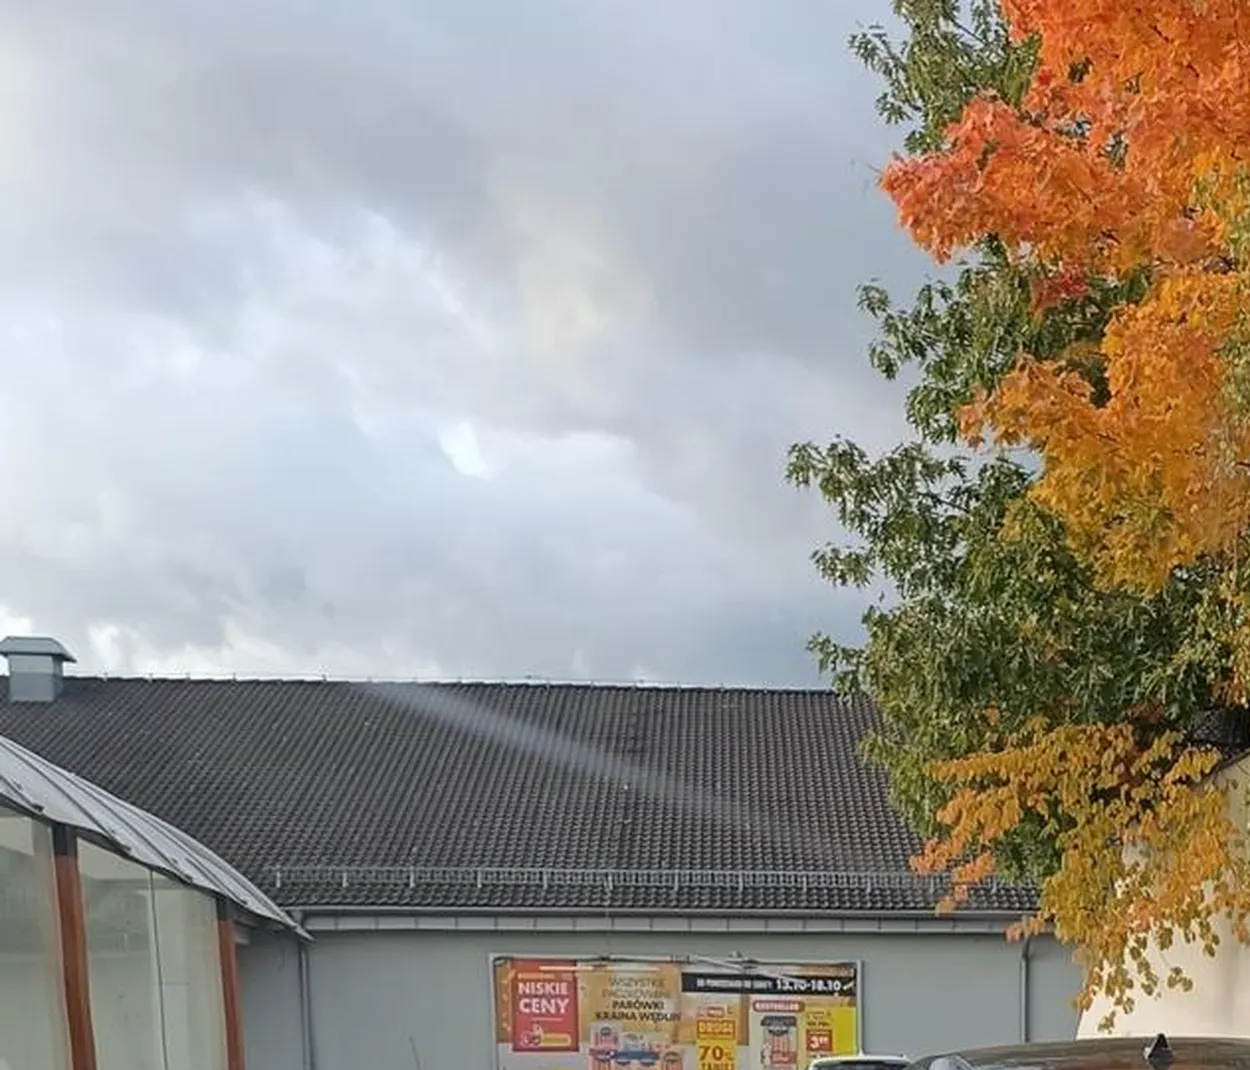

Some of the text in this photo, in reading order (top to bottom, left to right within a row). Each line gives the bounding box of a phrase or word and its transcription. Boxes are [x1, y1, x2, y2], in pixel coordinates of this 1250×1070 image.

[518, 982, 568, 995] NISKIE
[519, 999, 569, 1014] CENY
[612, 998, 664, 1010] PARÓWKI
